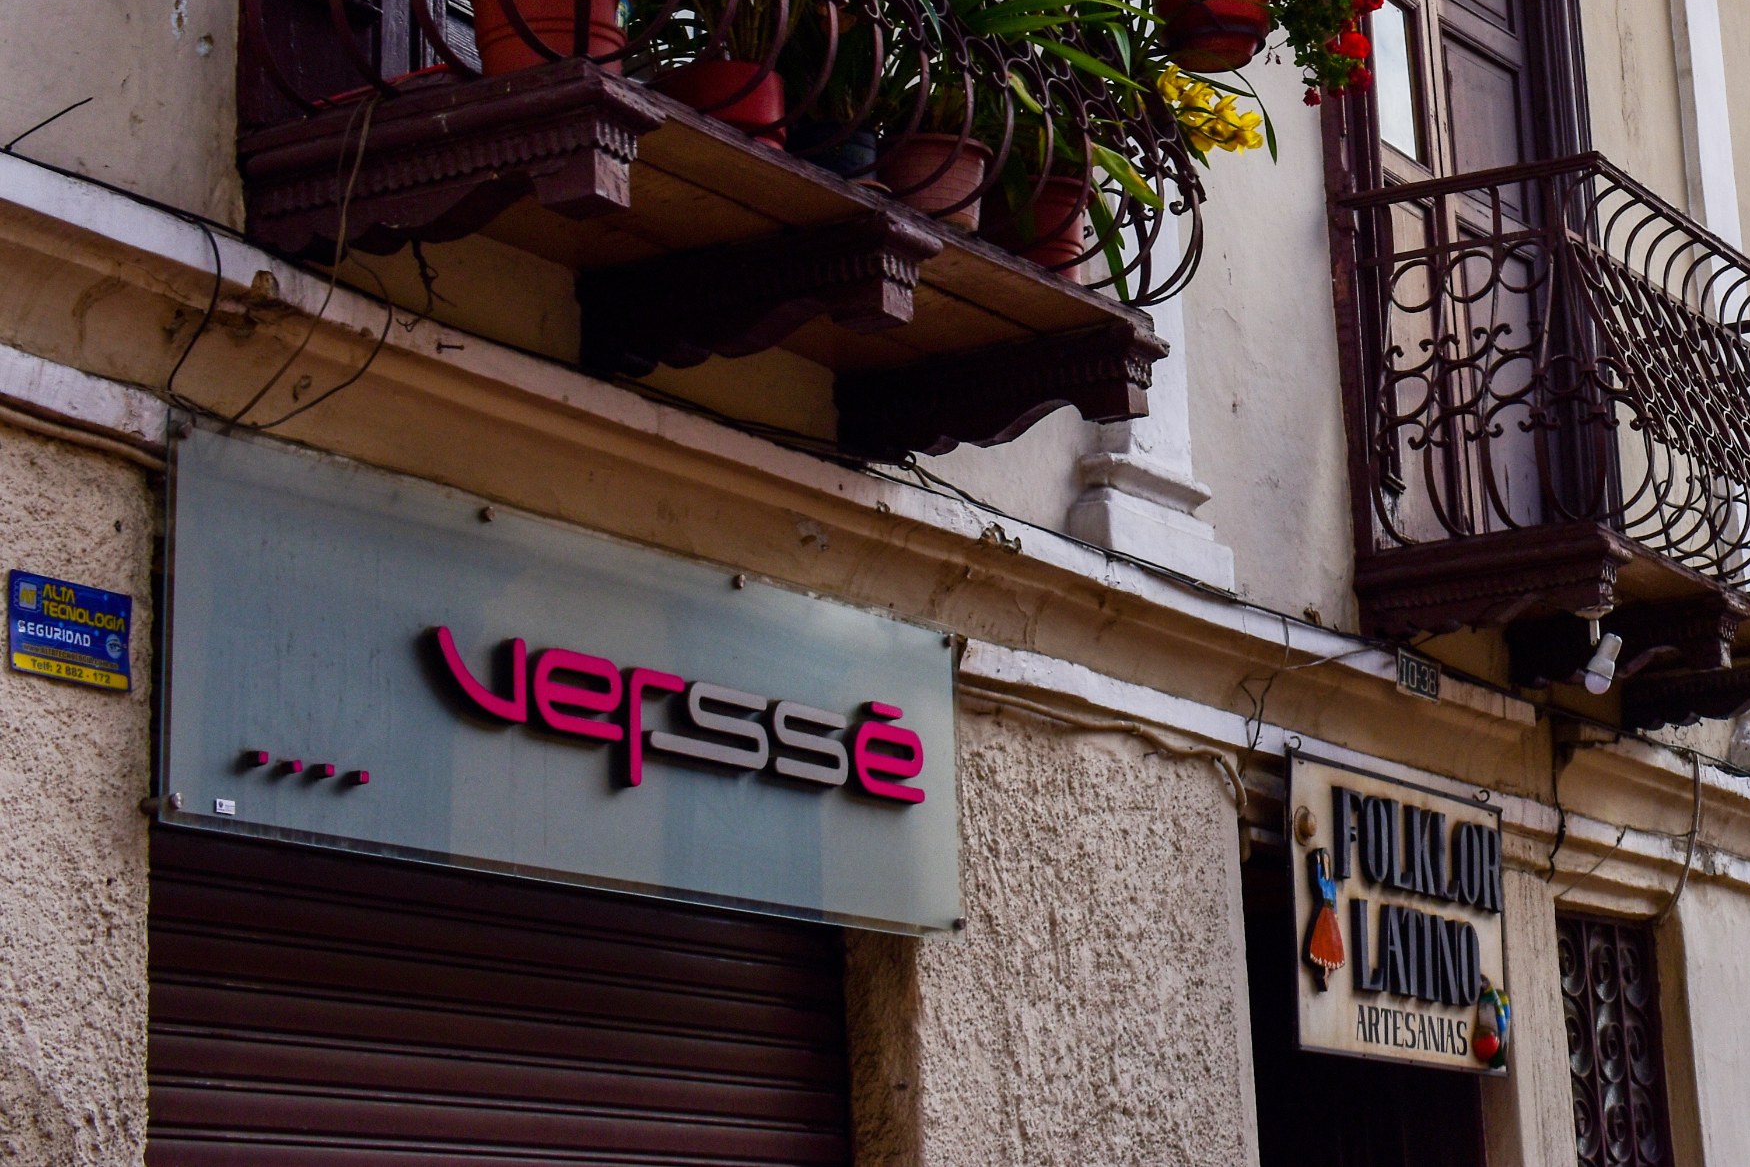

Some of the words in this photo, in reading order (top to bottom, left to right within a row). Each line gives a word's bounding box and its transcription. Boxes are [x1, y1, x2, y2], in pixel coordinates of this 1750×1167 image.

[42, 583, 76, 604] ALTA
[42, 599, 126, 633] TECNOLOGIA
[17, 619, 91, 648] SEGURIDAD
[93, 672, 111, 684] 172
[1331, 785, 1501, 913] FOLKLOR
[1349, 898, 1481, 1006] LATINO
[1356, 1004, 1468, 1056] ARTESANIAS
